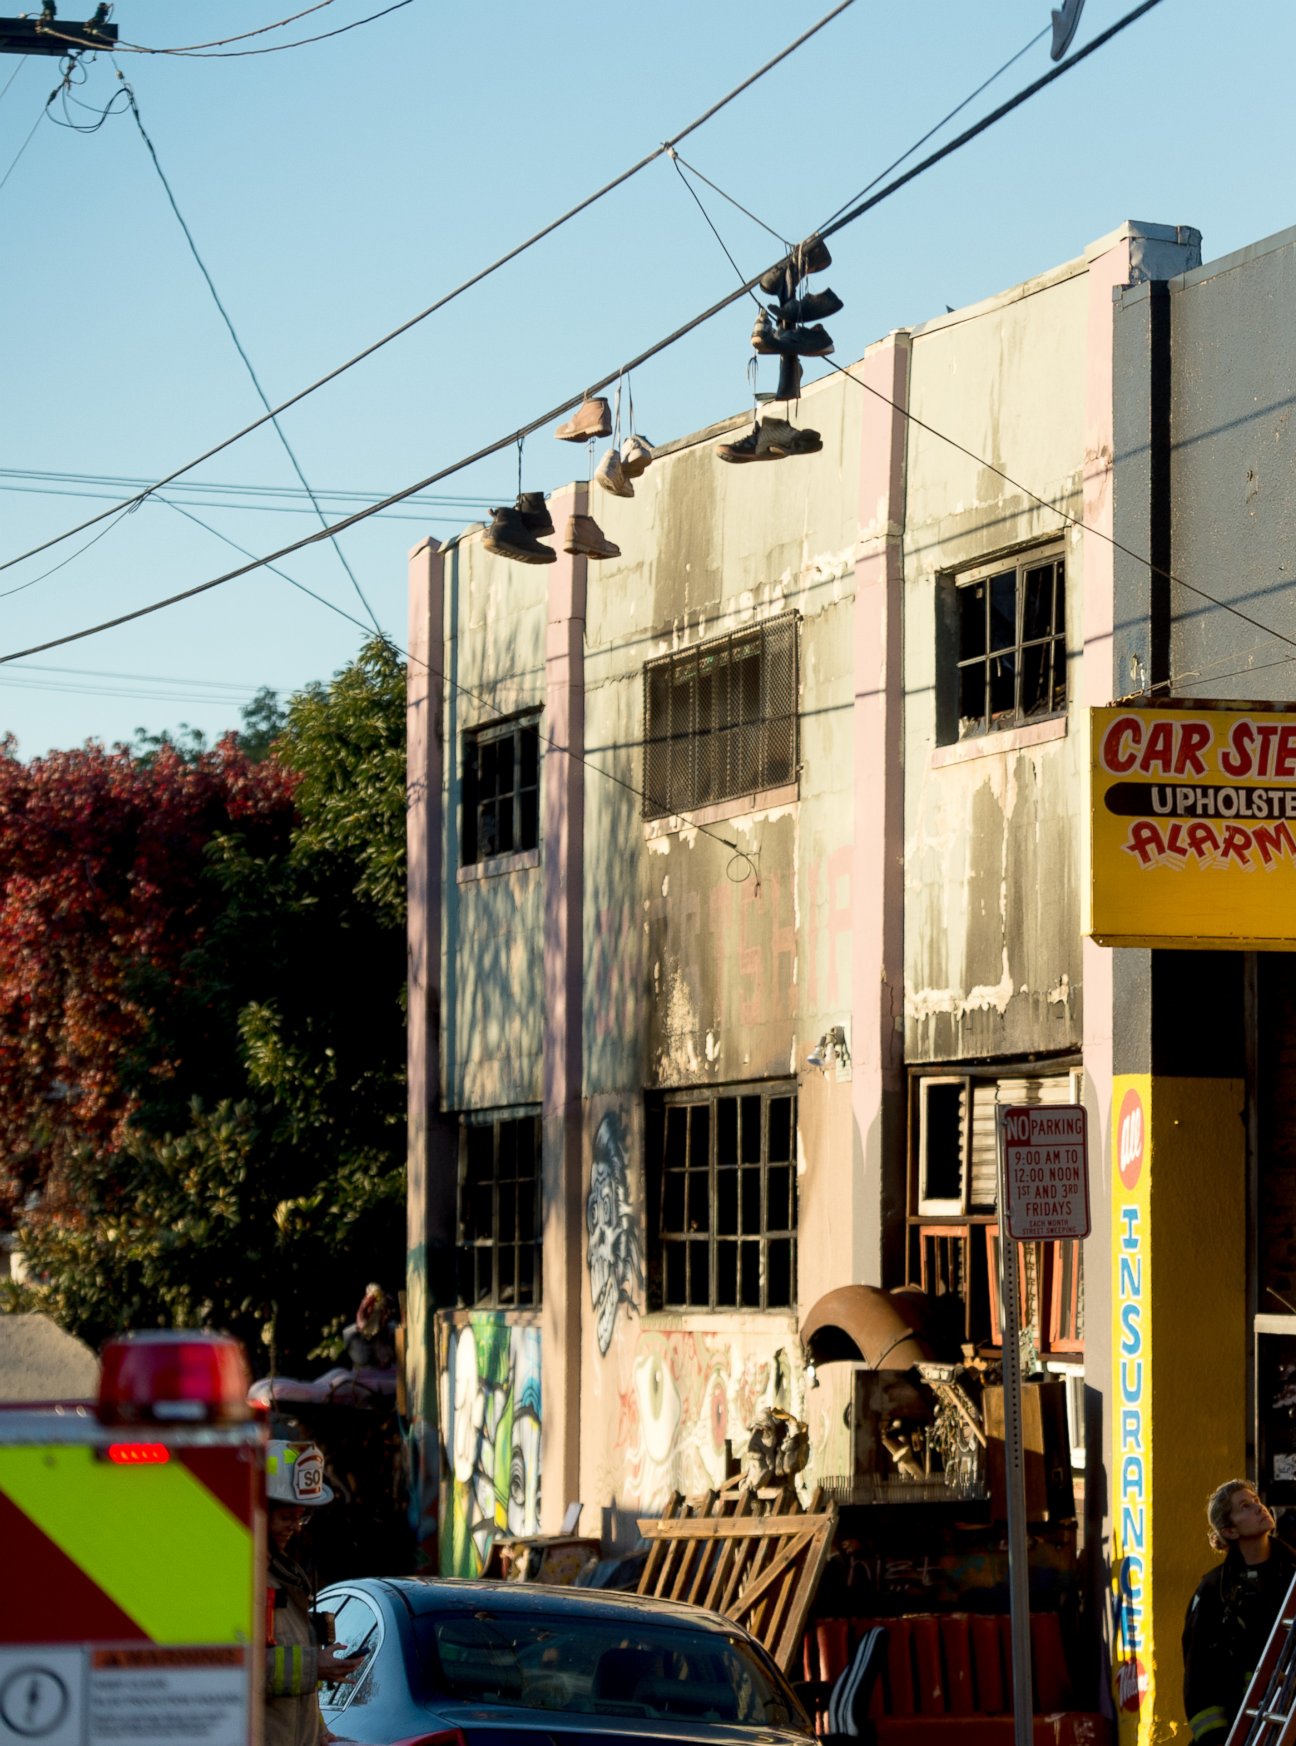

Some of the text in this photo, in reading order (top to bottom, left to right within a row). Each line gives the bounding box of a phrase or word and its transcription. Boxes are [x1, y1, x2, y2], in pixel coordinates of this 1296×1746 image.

[1102, 715, 1214, 778] CAR
[1007, 1115, 1082, 1141] NO PARKING
[1015, 1149, 1078, 1166] 9:00 AM TO
[1014, 1166, 1080, 1184] 12:00 NOON
[1017, 1183, 1078, 1201] 1ST AND 3RD
[1026, 1201, 1072, 1217] FRIDAYS
[1022, 1227, 1044, 1235] STREET
[1047, 1219, 1069, 1227] MONTH
[1119, 1206, 1144, 1650] INSURANCE
